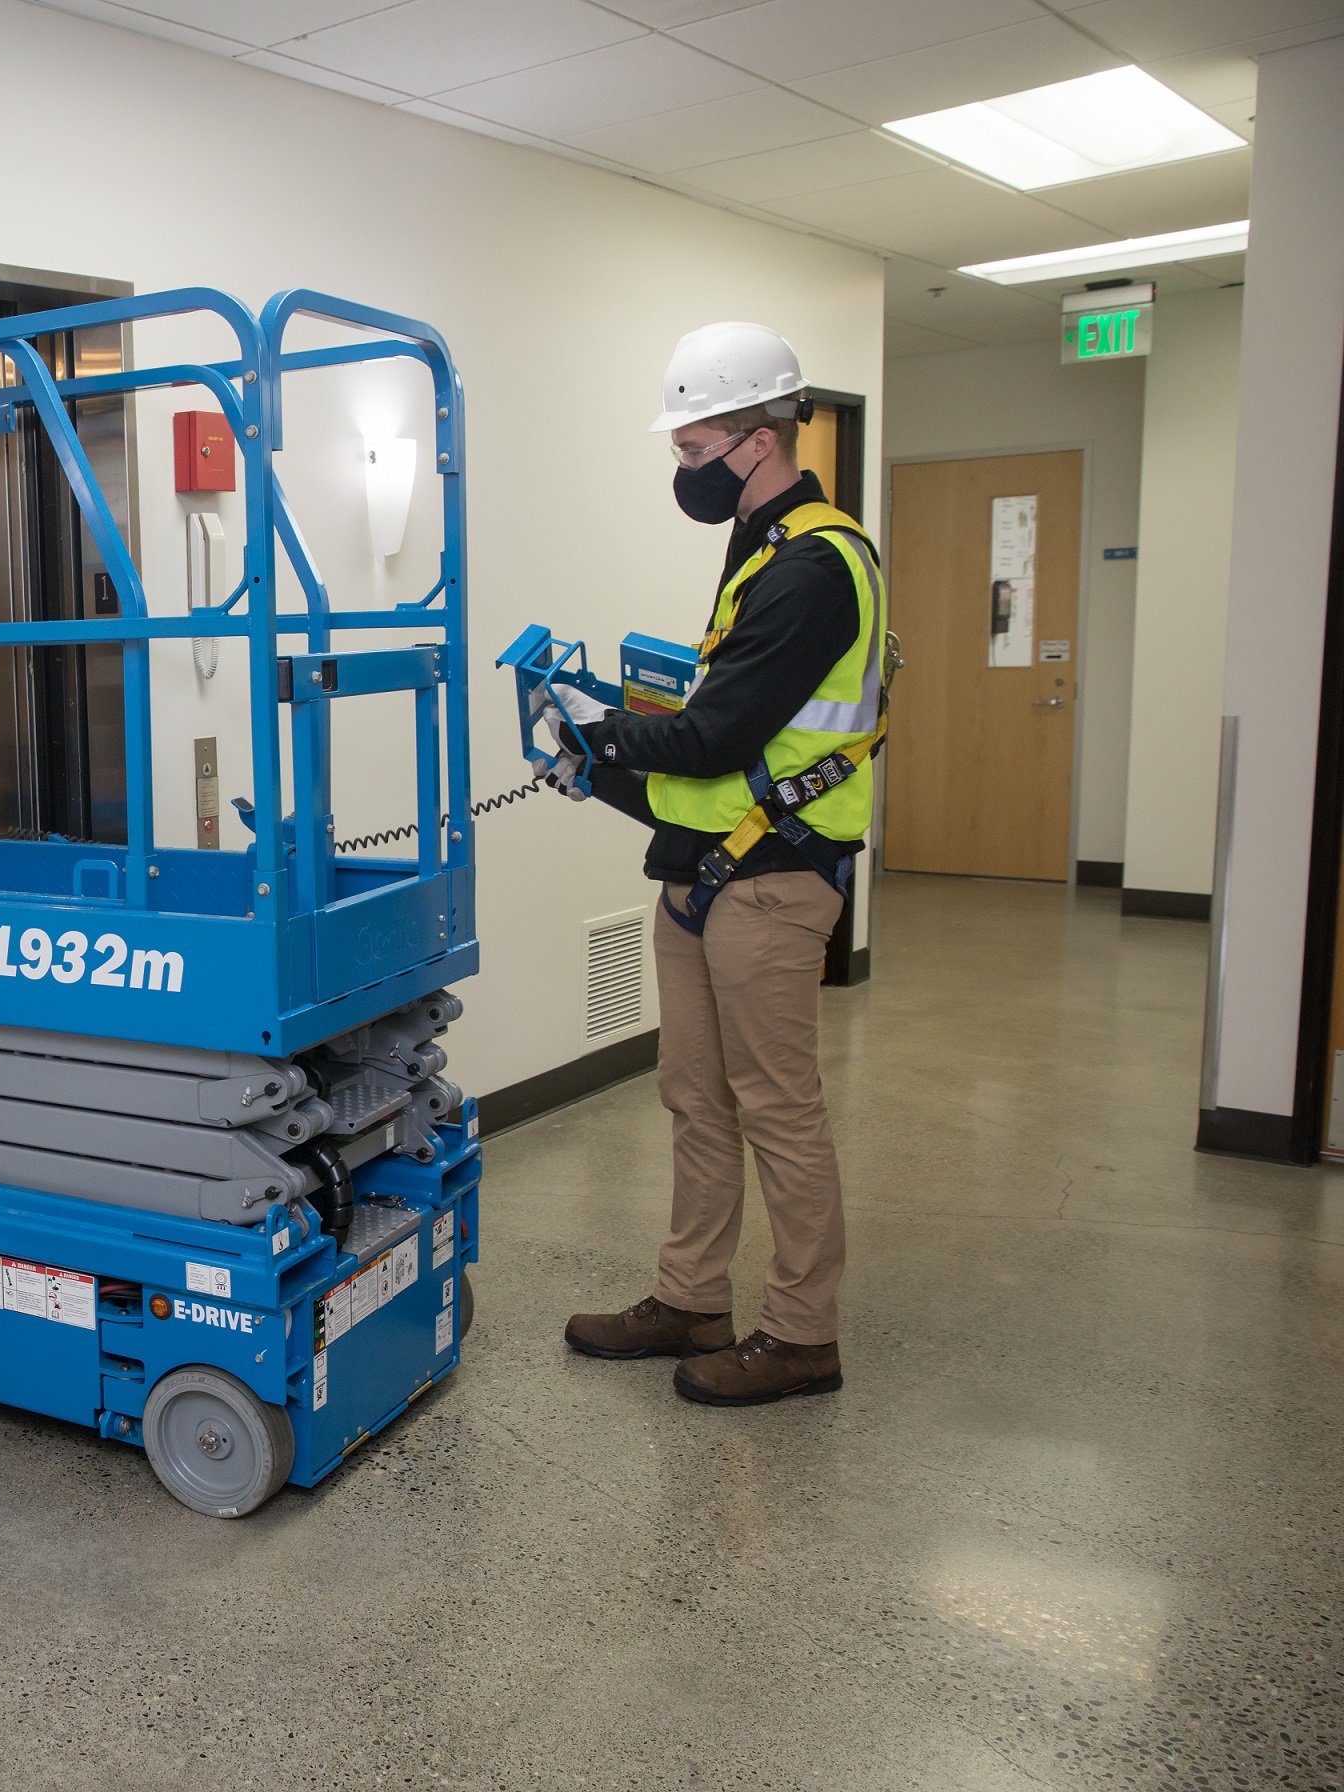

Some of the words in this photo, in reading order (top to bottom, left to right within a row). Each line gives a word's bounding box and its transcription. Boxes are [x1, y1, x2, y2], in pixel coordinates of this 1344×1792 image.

[1077, 309, 1141, 359] EXIT
[823, 765, 837, 782] SALA
[782, 783, 796, 801] SALA
[17, 1262, 37, 1272] DANGER
[63, 1272, 80, 1281] DANGER
[174, 1299, 253, 1334] E-DRIVE
